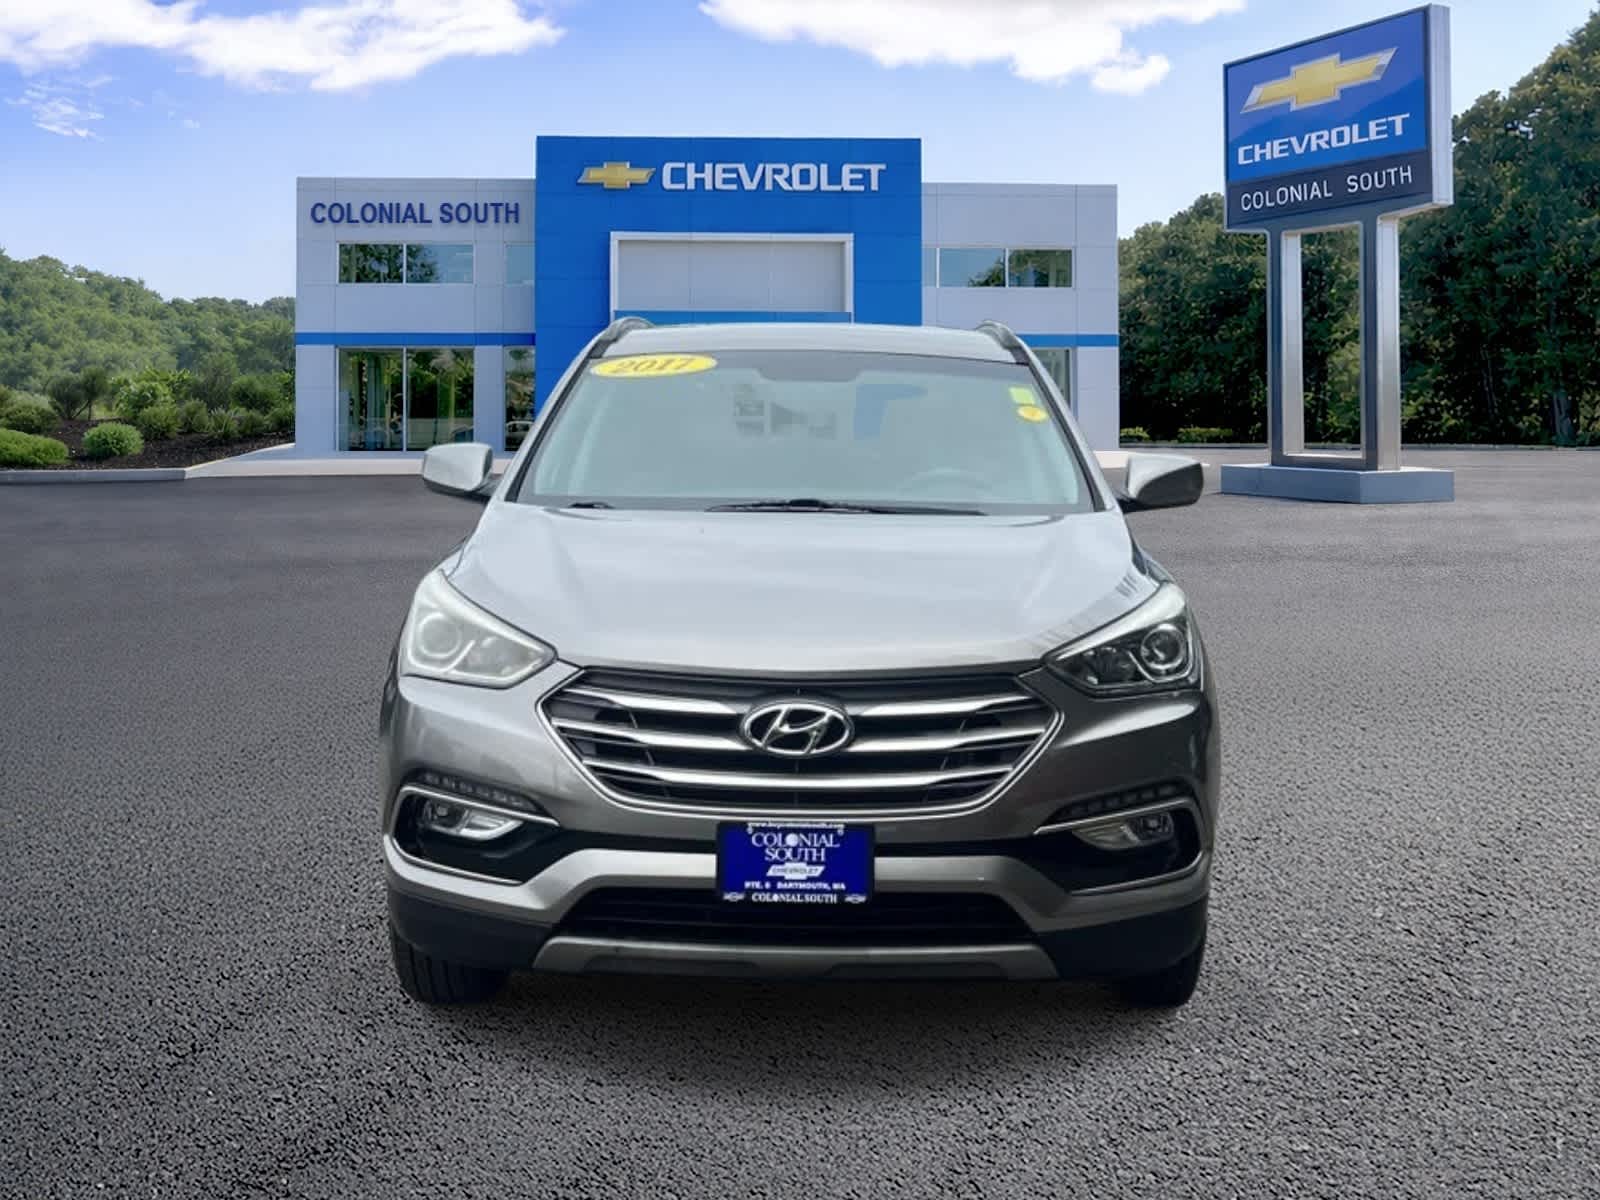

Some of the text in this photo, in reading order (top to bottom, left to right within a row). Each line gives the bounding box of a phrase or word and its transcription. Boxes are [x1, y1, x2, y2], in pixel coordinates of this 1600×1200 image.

[1237, 113, 1410, 165] CHEVROLET
[661, 162, 887, 191] CHEVROLET
[1241, 165, 1413, 211] COLONIAL SOUTH
[310, 202, 520, 225] COLONIAL SOUTH
[611, 358, 697, 374] 2017
[751, 832, 840, 848] COLONIAL
[764, 847, 826, 862] SOUTH
[751, 892, 838, 904] COLONIAL SOUTH
